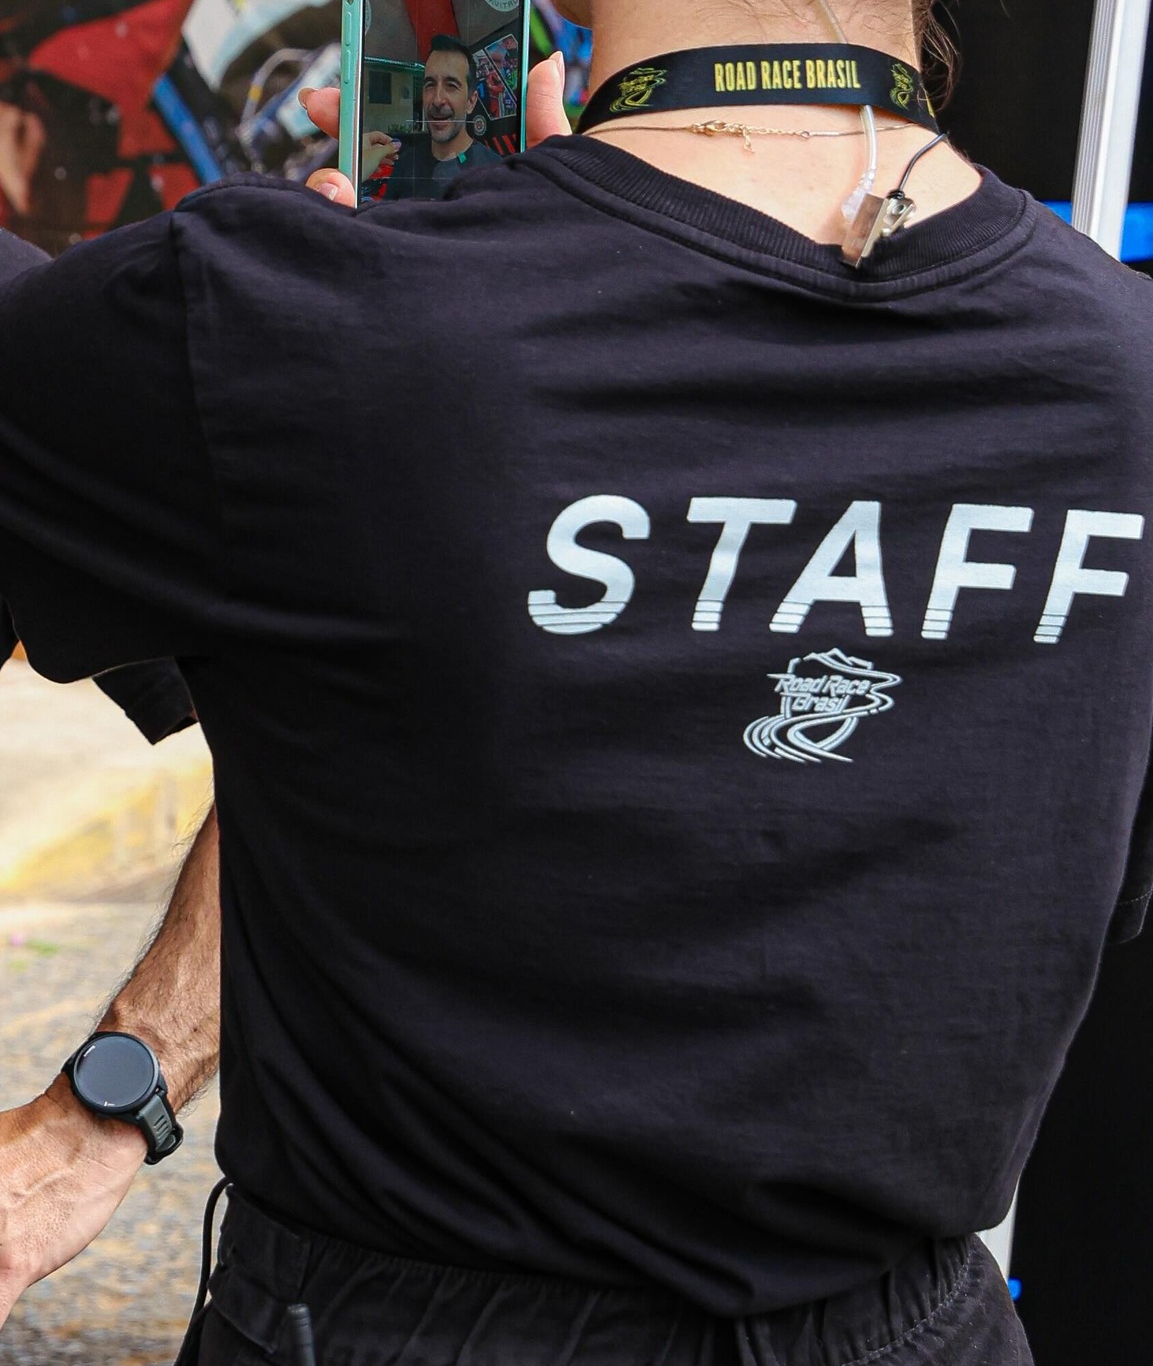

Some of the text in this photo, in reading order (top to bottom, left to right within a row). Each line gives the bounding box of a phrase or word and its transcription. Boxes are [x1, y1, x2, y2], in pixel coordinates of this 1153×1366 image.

[714, 62, 755, 92] ROAD
[761, 61, 802, 90] RACE
[806, 59, 861, 89] BRASIL
[528, 494, 1145, 644] STAFF
[770, 674, 871, 696] Road Race
[782, 691, 851, 712] Brasil
